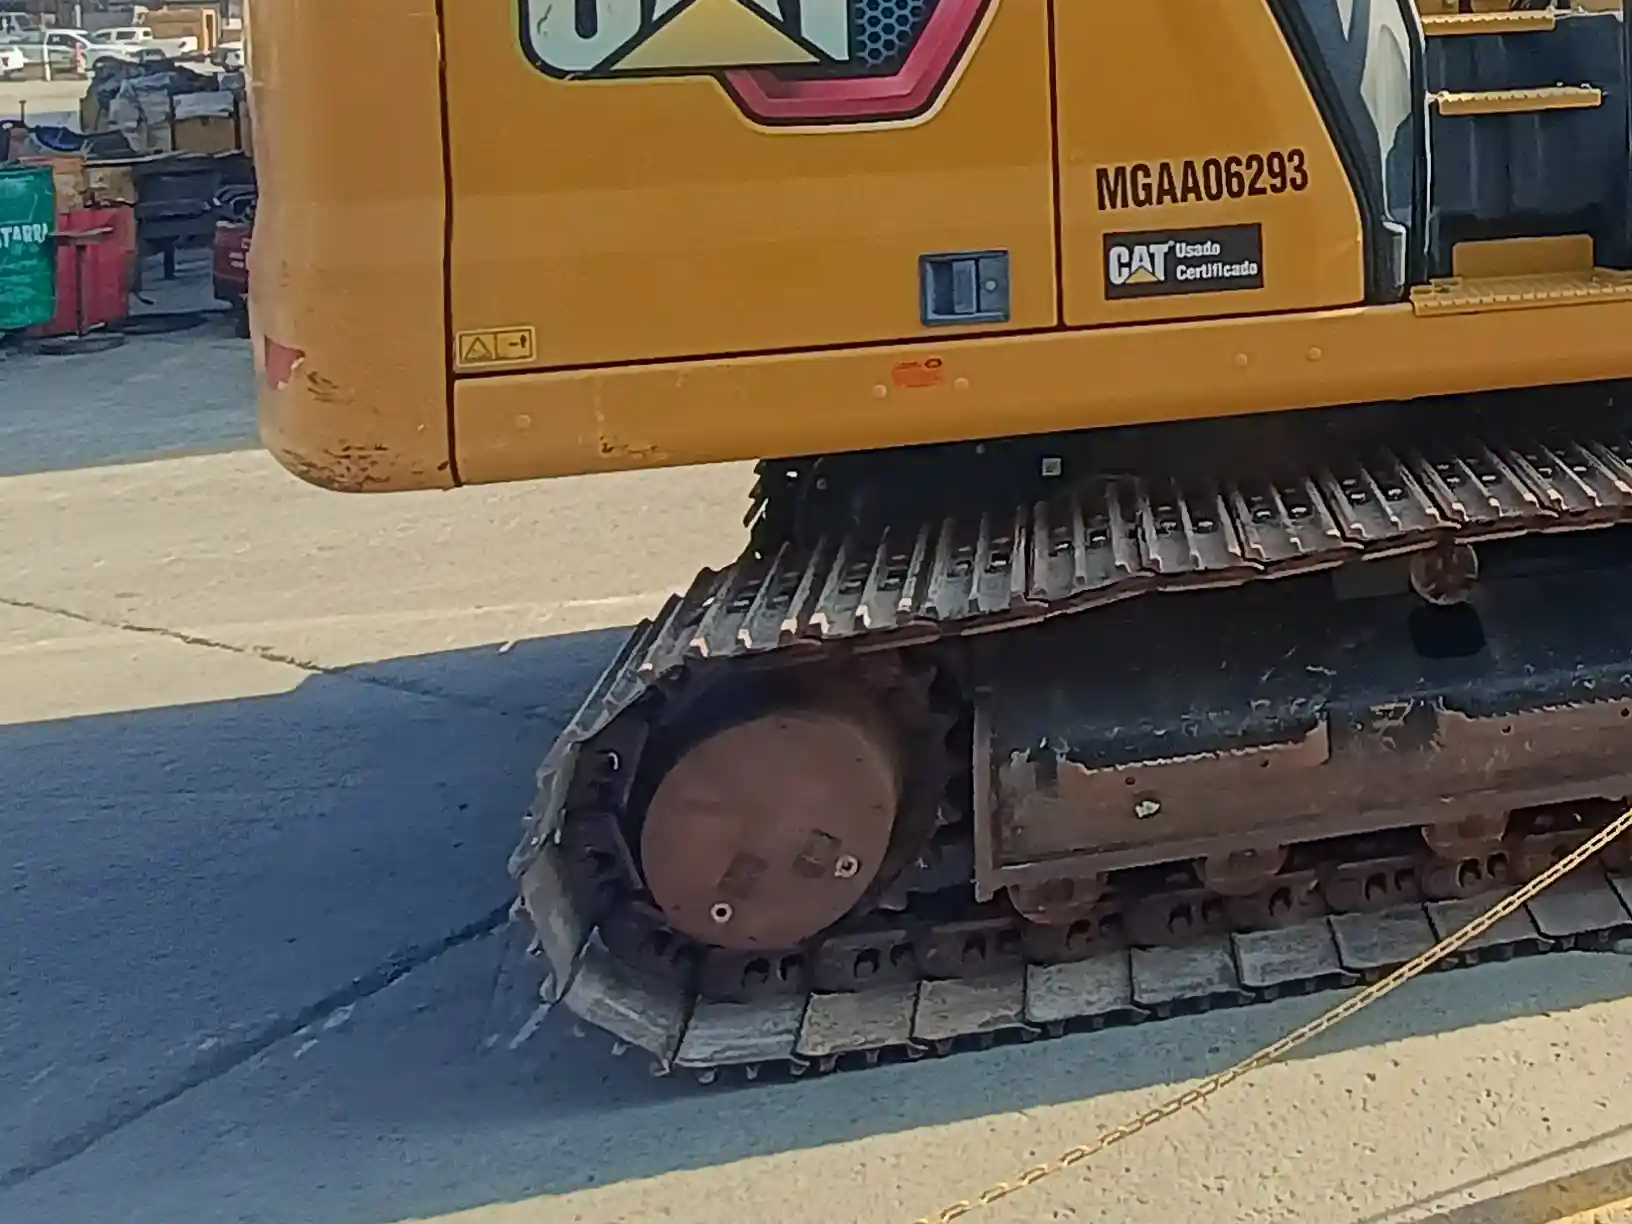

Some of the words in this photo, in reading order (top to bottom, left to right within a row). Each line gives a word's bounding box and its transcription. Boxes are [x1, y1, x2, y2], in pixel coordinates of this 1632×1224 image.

[1095, 148, 1309, 211] MGAA06293
[1108, 242, 1170, 285] CAT
[1175, 240, 1221, 258] Usado
[1176, 260, 1259, 281] Certificado
